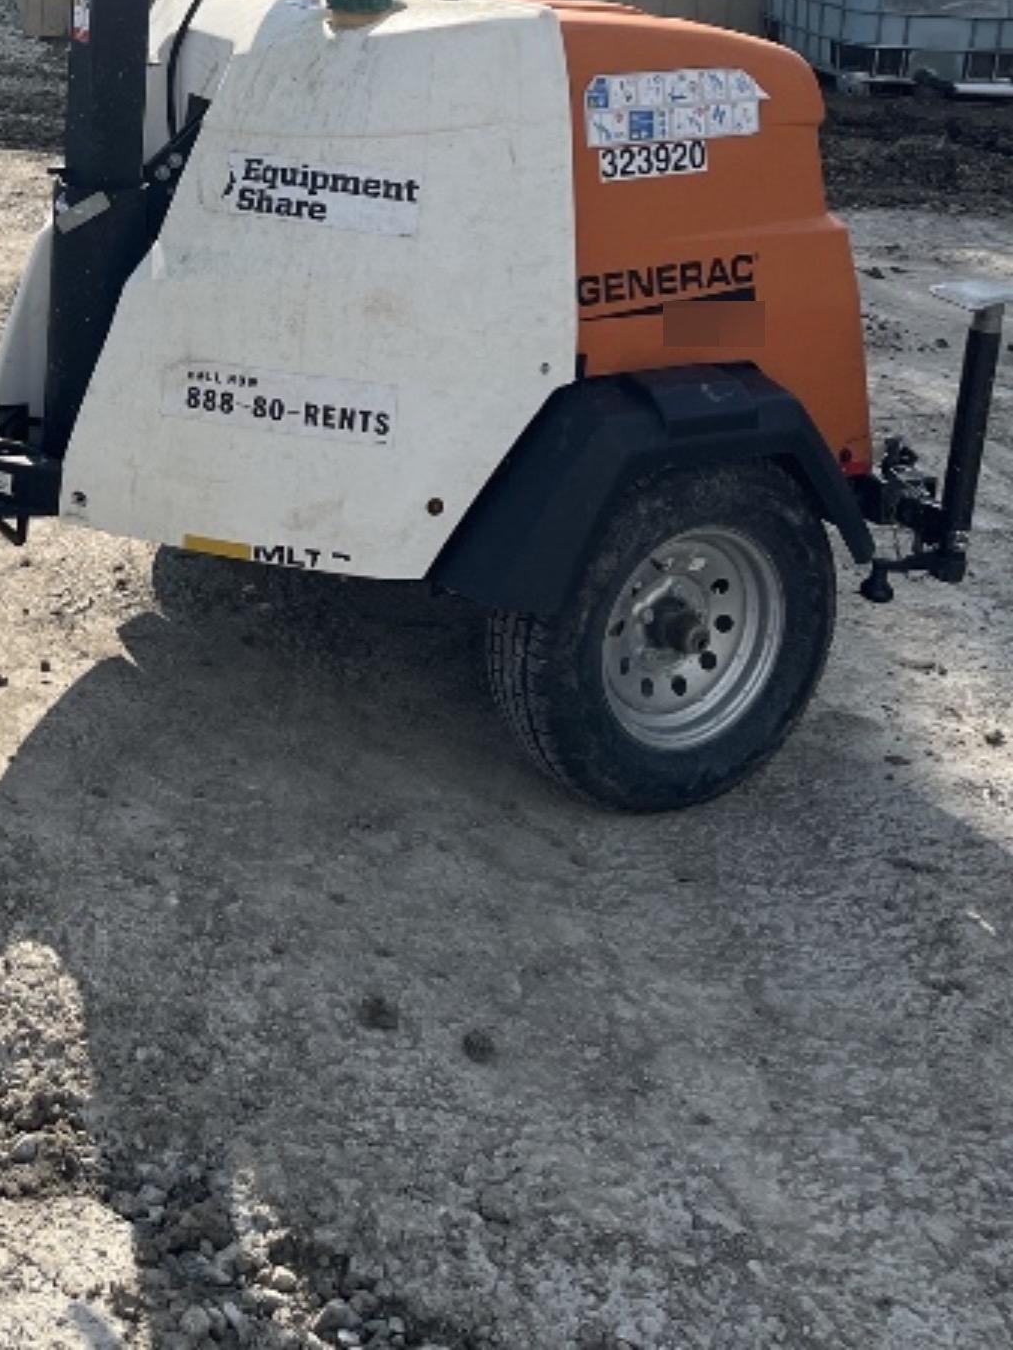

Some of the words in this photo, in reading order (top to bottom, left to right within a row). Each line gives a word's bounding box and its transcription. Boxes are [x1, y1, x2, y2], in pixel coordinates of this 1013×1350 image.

[601, 141, 707, 178] 323920
[242, 158, 420, 203] Equipment
[236, 186, 327, 221] Share
[578, 254, 754, 306] GENERAC
